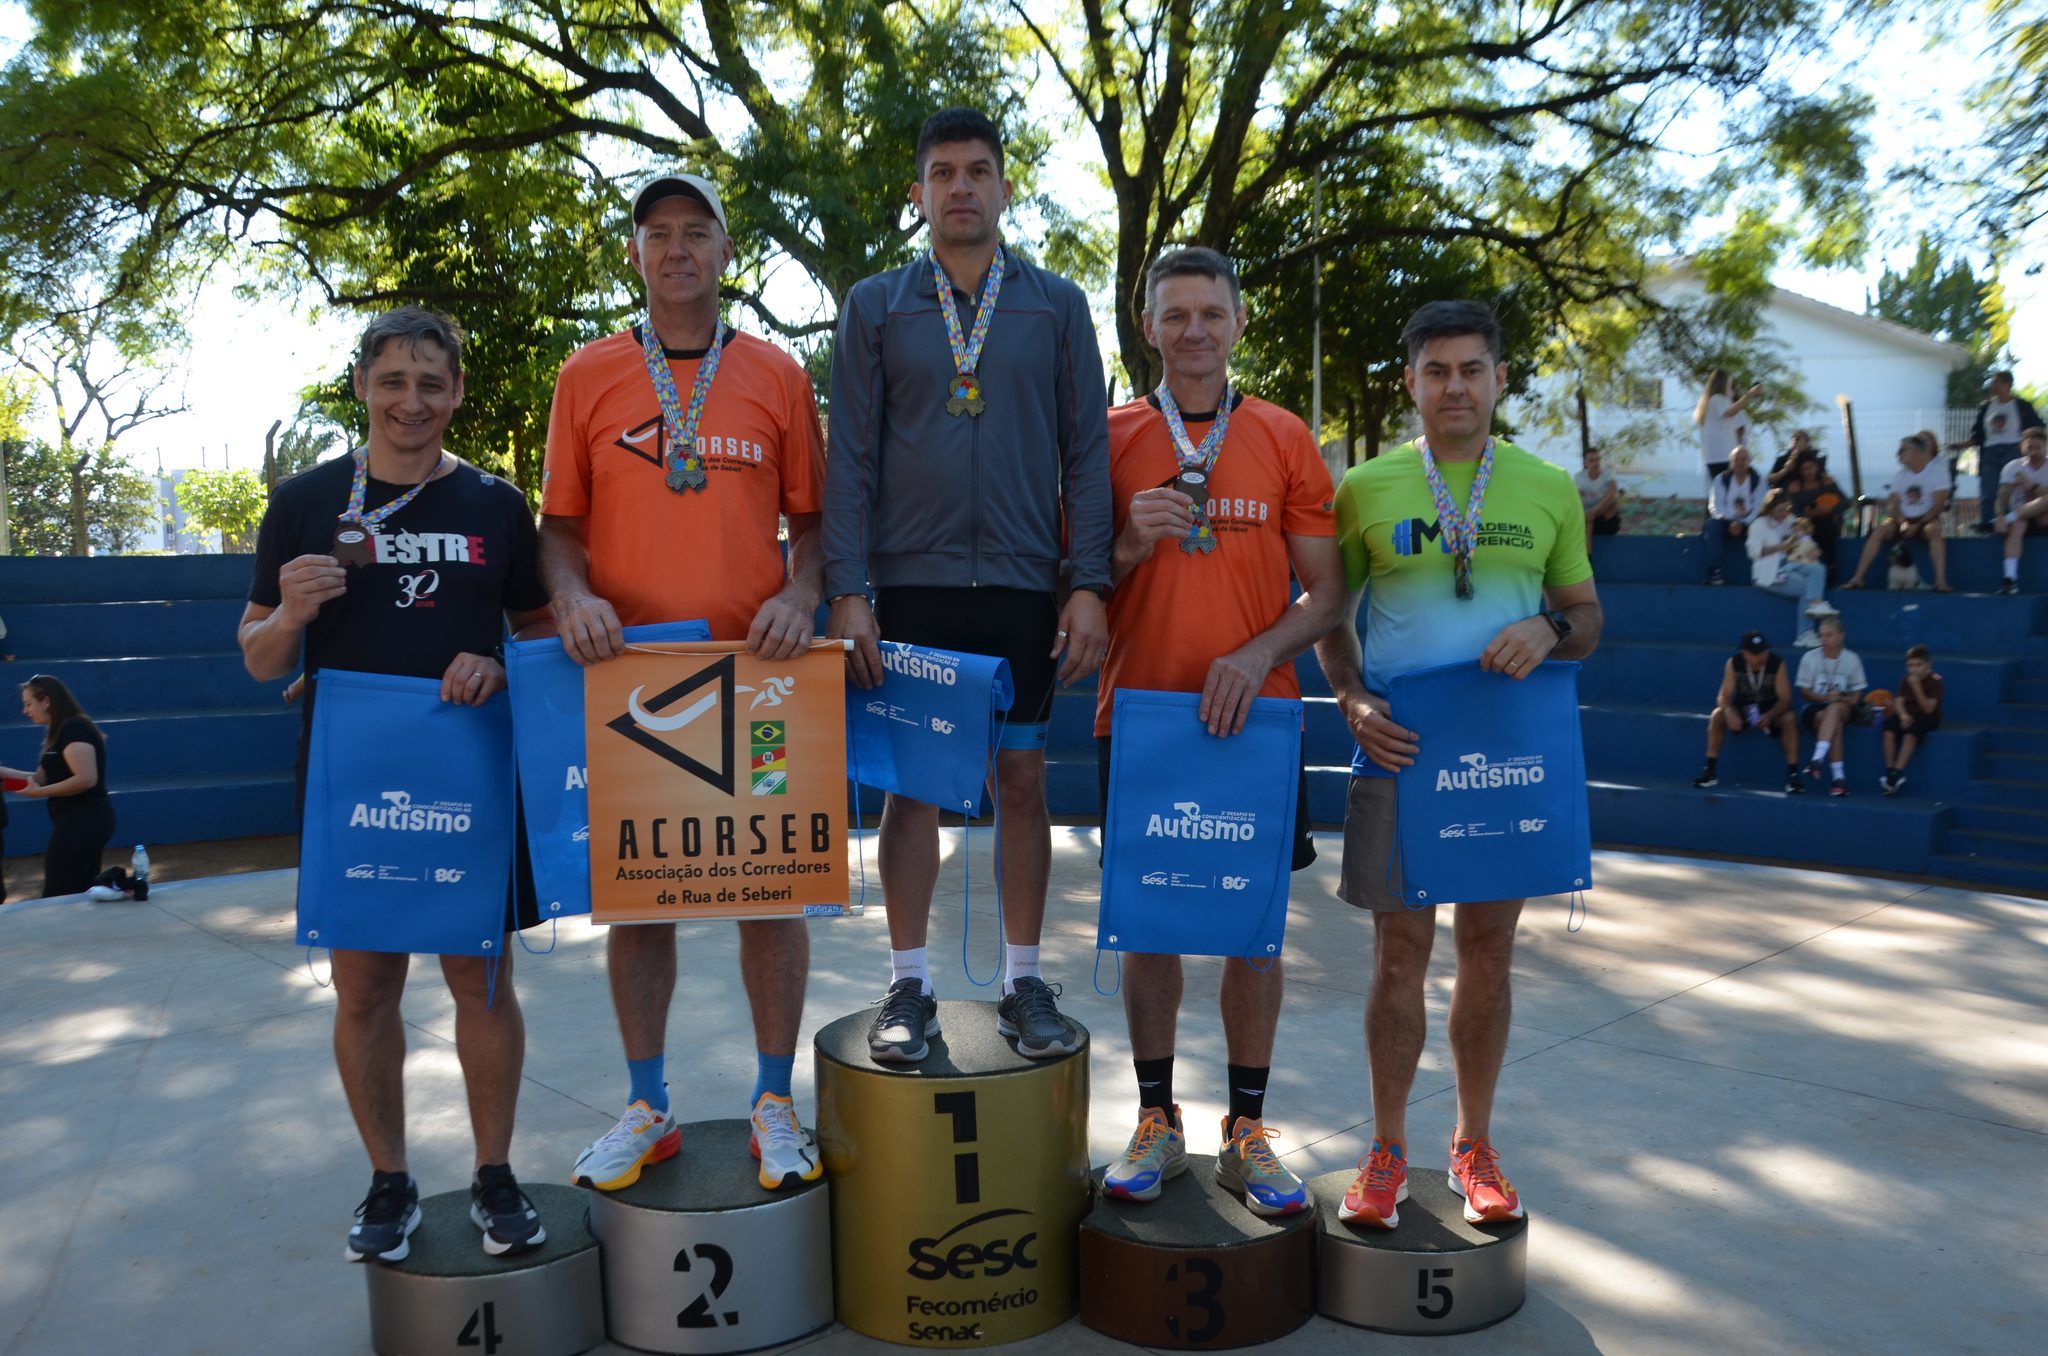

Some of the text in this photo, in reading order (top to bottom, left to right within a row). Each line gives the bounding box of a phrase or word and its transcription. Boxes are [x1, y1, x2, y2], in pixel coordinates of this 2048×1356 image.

[665, 436, 763, 463] AORSEB
[881, 651, 956, 686] utismo
[1436, 765, 1545, 792] Autismo
[349, 803, 471, 833] Autismo
[1145, 813, 1255, 842] Autismo
[618, 812, 831, 861] ACORSEB
[616, 859, 831, 883] Associação dos Corredores
[656, 885, 792, 905] de Rua de Seberi
[934, 1091, 980, 1204] 1
[673, 1243, 739, 1328] 2
[1165, 1258, 1226, 1343] 3
[1416, 1267, 1454, 1320] 5
[906, 1287, 1038, 1317] Fecomércio
[457, 1301, 503, 1356] 4
[908, 1321, 982, 1342] Senac
